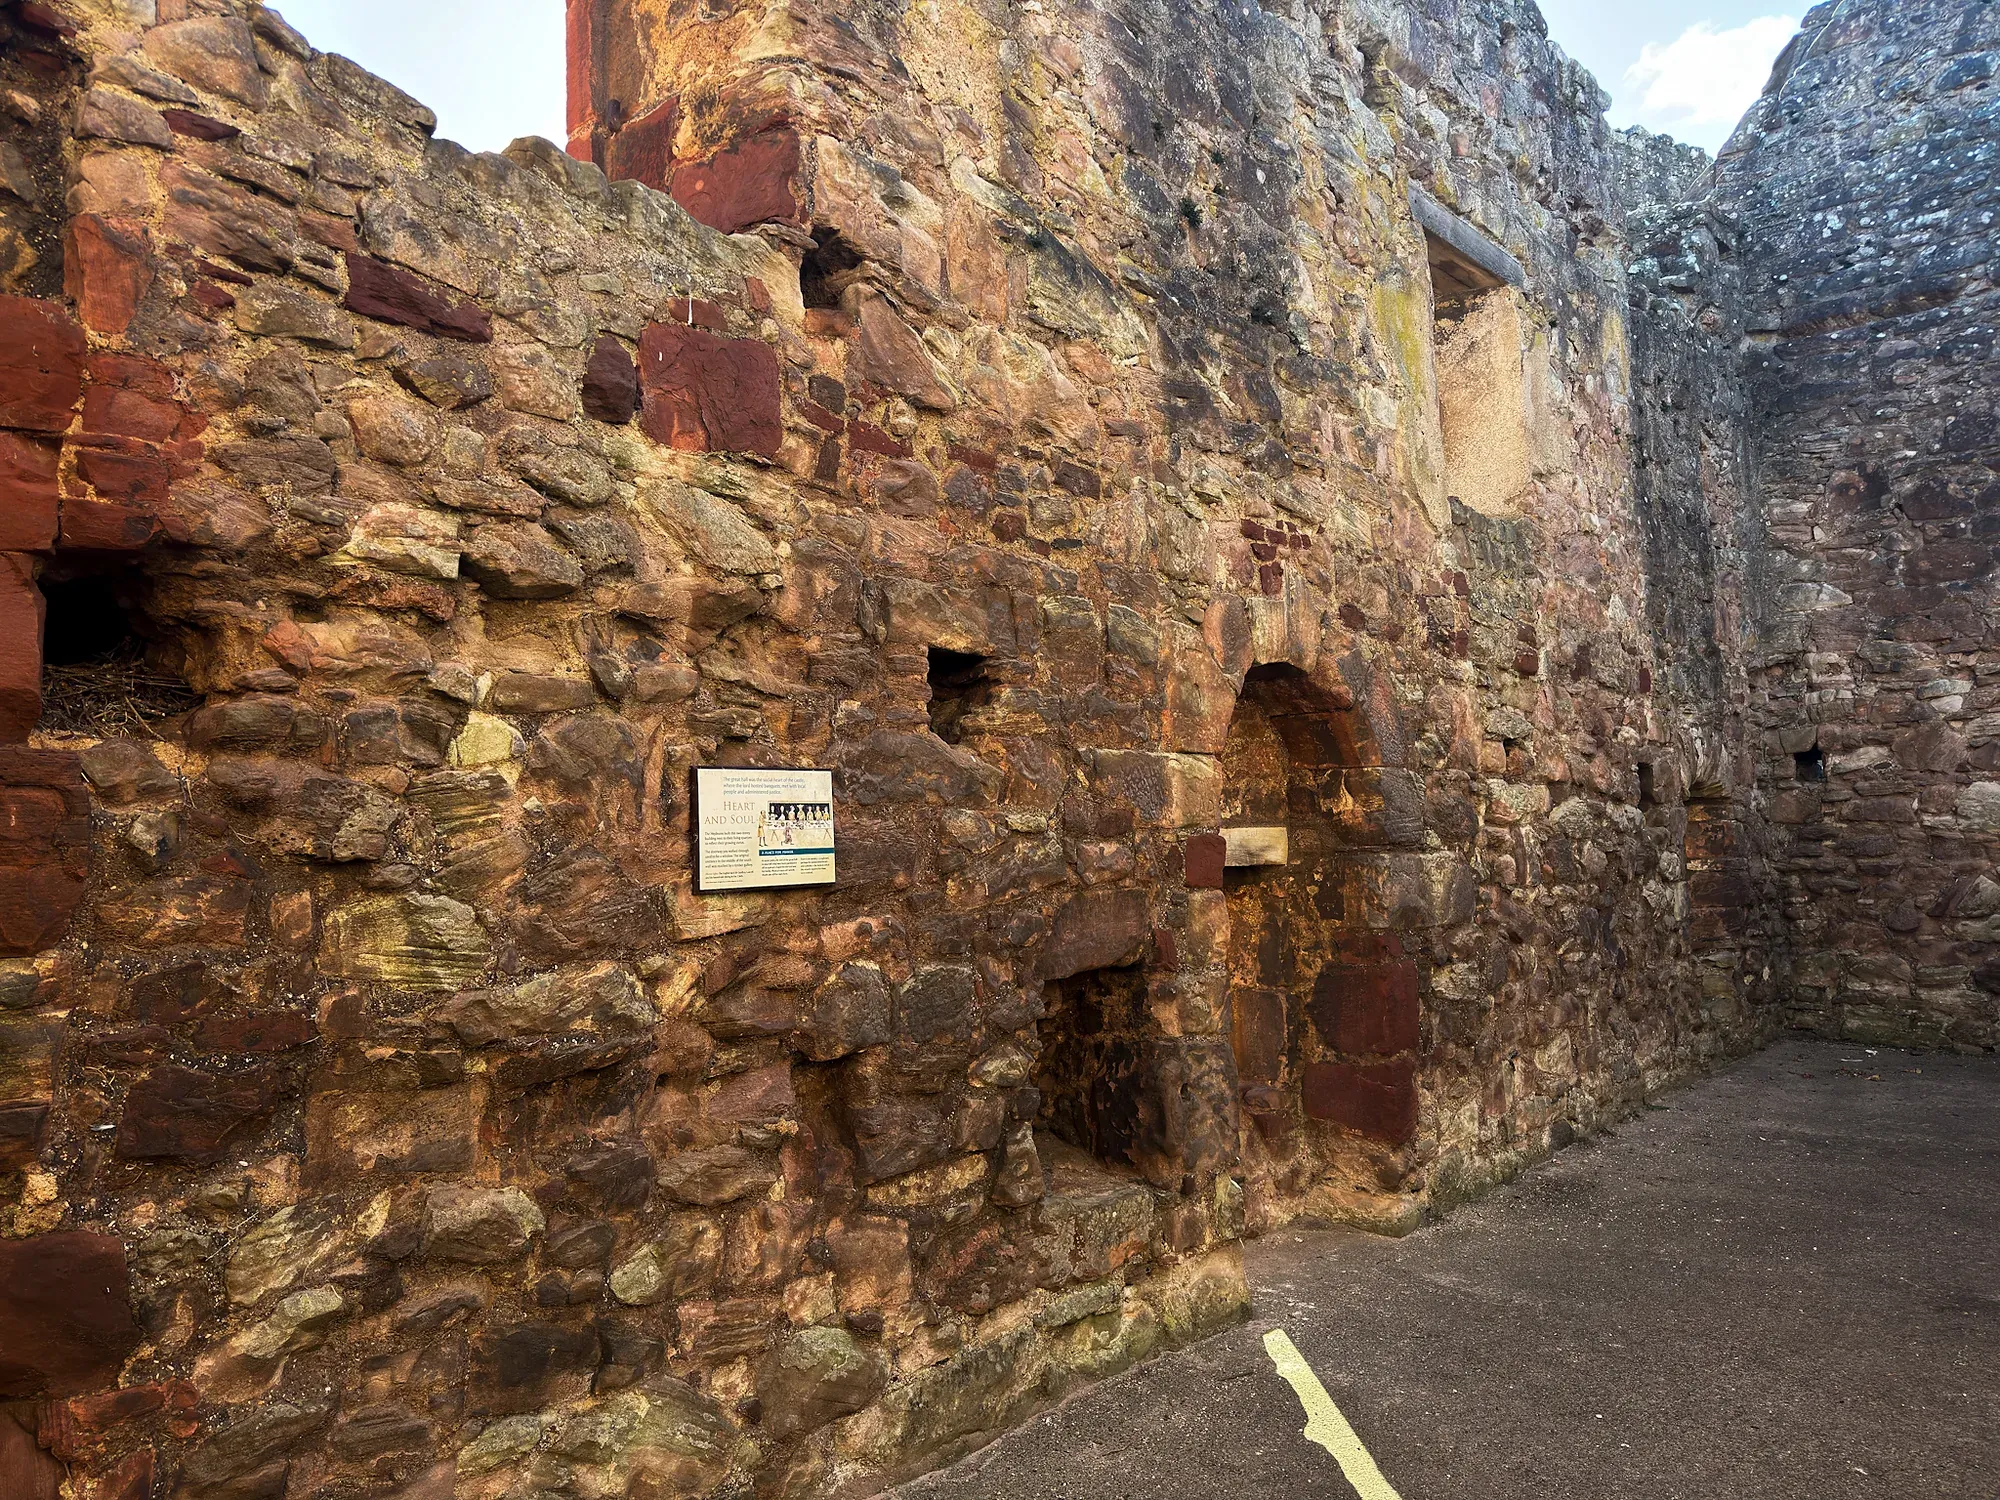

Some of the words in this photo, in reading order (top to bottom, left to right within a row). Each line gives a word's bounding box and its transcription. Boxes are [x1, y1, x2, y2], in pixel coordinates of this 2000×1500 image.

[724, 801, 755, 811] HEART
[704, 815, 727, 824] AND
[730, 814, 755, 824] SOUL
